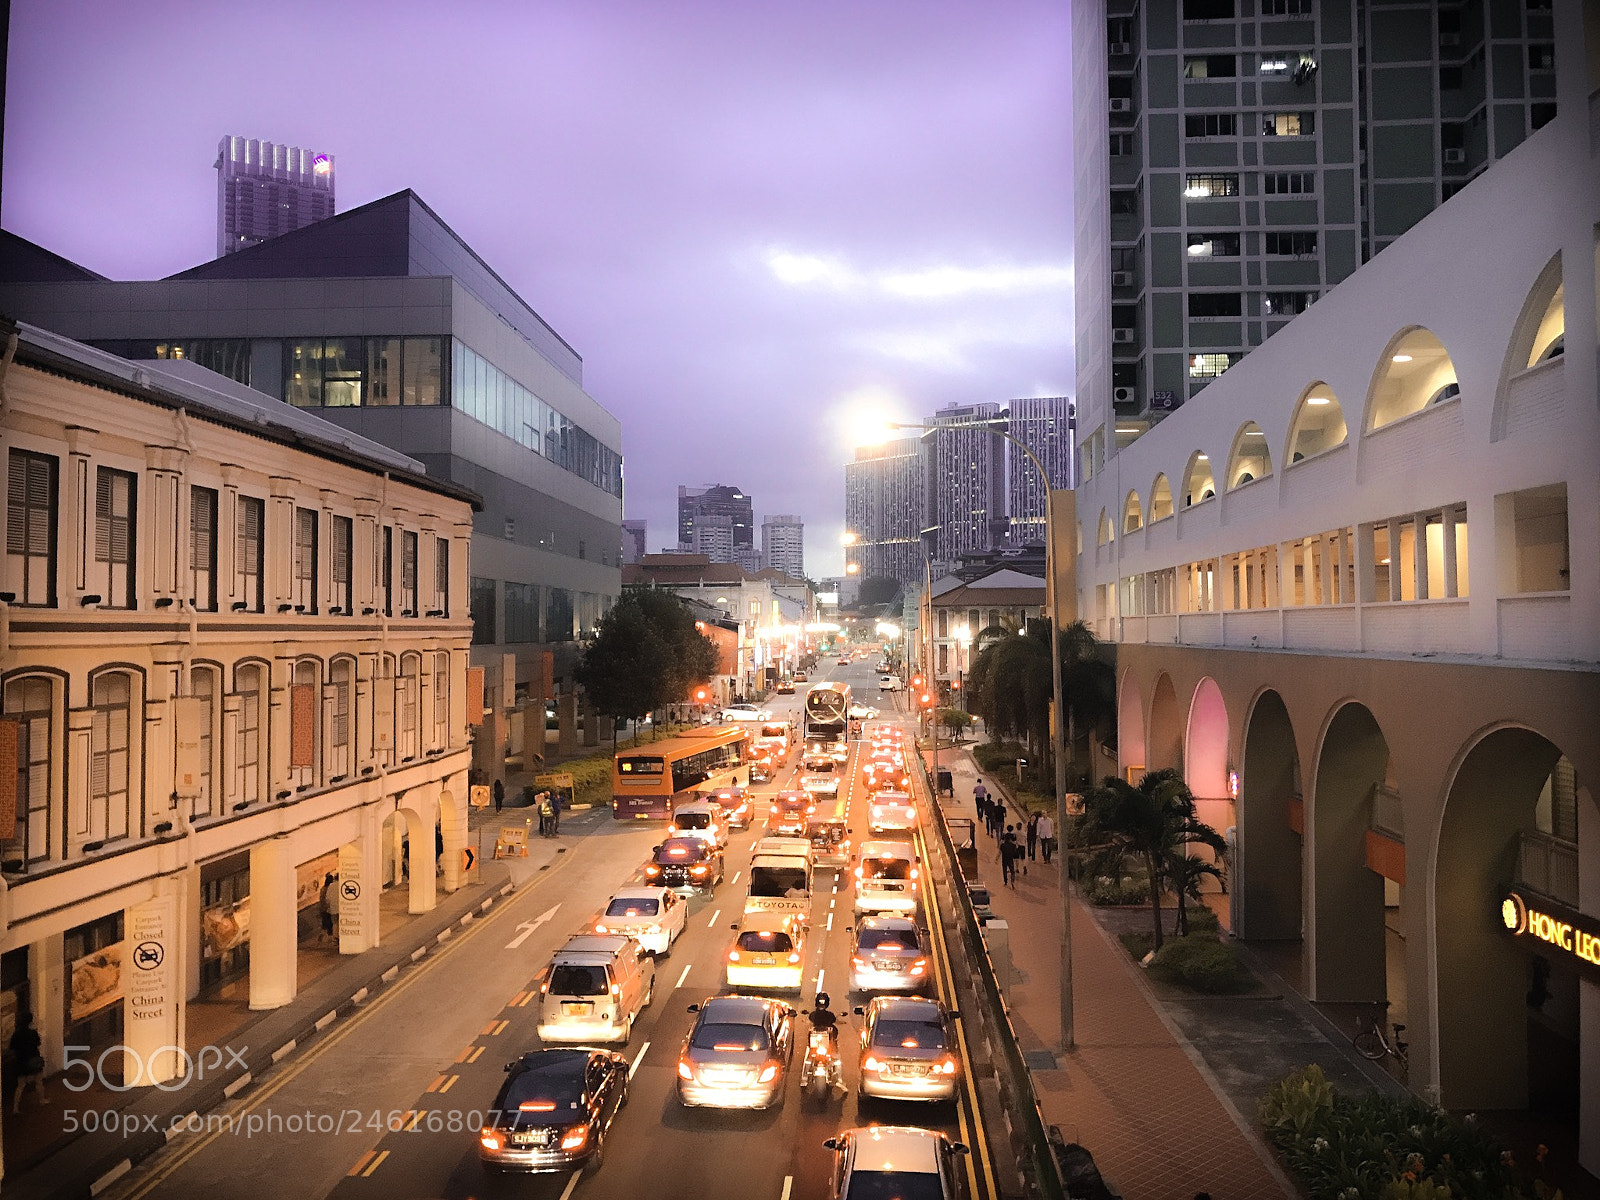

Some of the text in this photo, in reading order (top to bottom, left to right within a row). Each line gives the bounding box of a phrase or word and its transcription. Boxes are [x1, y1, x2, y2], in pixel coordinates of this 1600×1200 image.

[1155, 391, 1172, 400] 532
[757, 901, 798, 909] TOYOTA
[133, 930, 164, 941] Closed
[1528, 909, 1600, 966] HONG LEO
[131, 995, 165, 1007] China
[132, 1007, 164, 1019] Street
